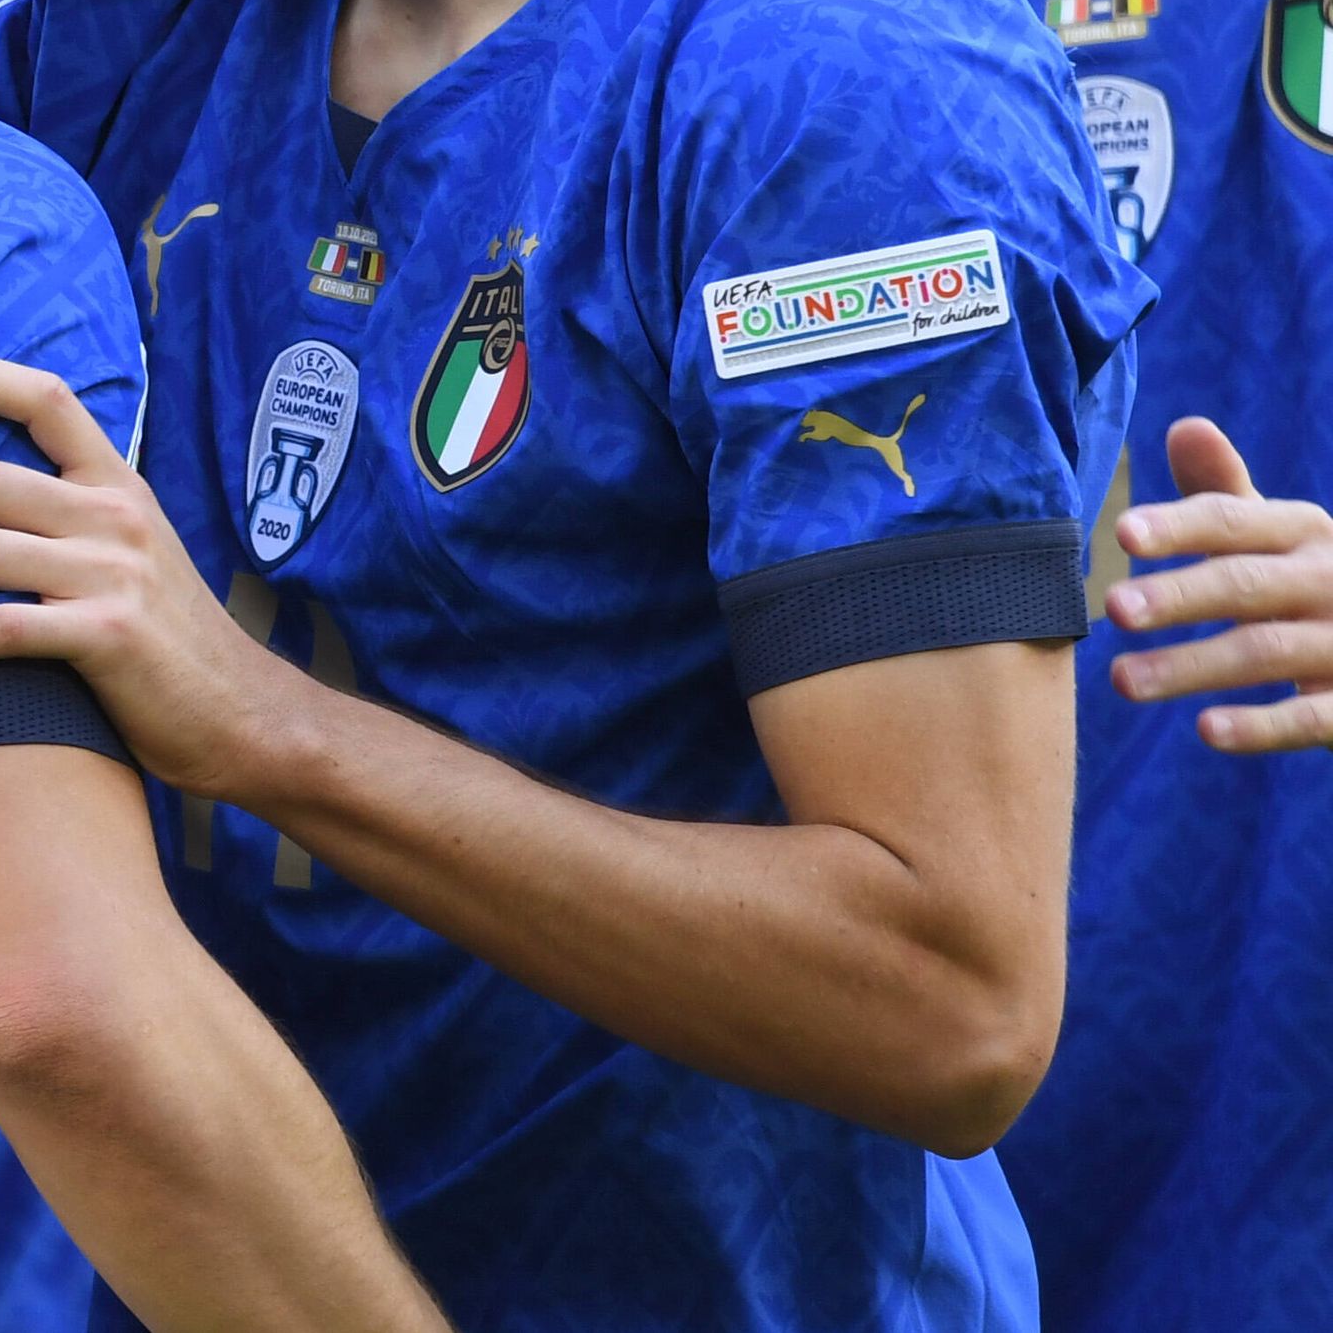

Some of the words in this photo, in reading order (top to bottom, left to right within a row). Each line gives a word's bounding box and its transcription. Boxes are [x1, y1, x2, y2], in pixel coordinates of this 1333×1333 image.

[1086, 87, 1125, 111] EFA
[1087, 119, 1149, 138] OPEAN
[356, 287, 370, 301] ITA
[468, 286, 523, 319] ITALI
[713, 280, 773, 308] UEFA
[716, 261, 995, 343] FOUNDATION
[913, 315, 933, 336] for
[940, 302, 1000, 326] children
[295, 353, 334, 381] UEFA
[276, 378, 344, 408] EUROPEAN
[272, 398, 338, 426] CHAMPIONS
[257, 518, 291, 541] 2020
